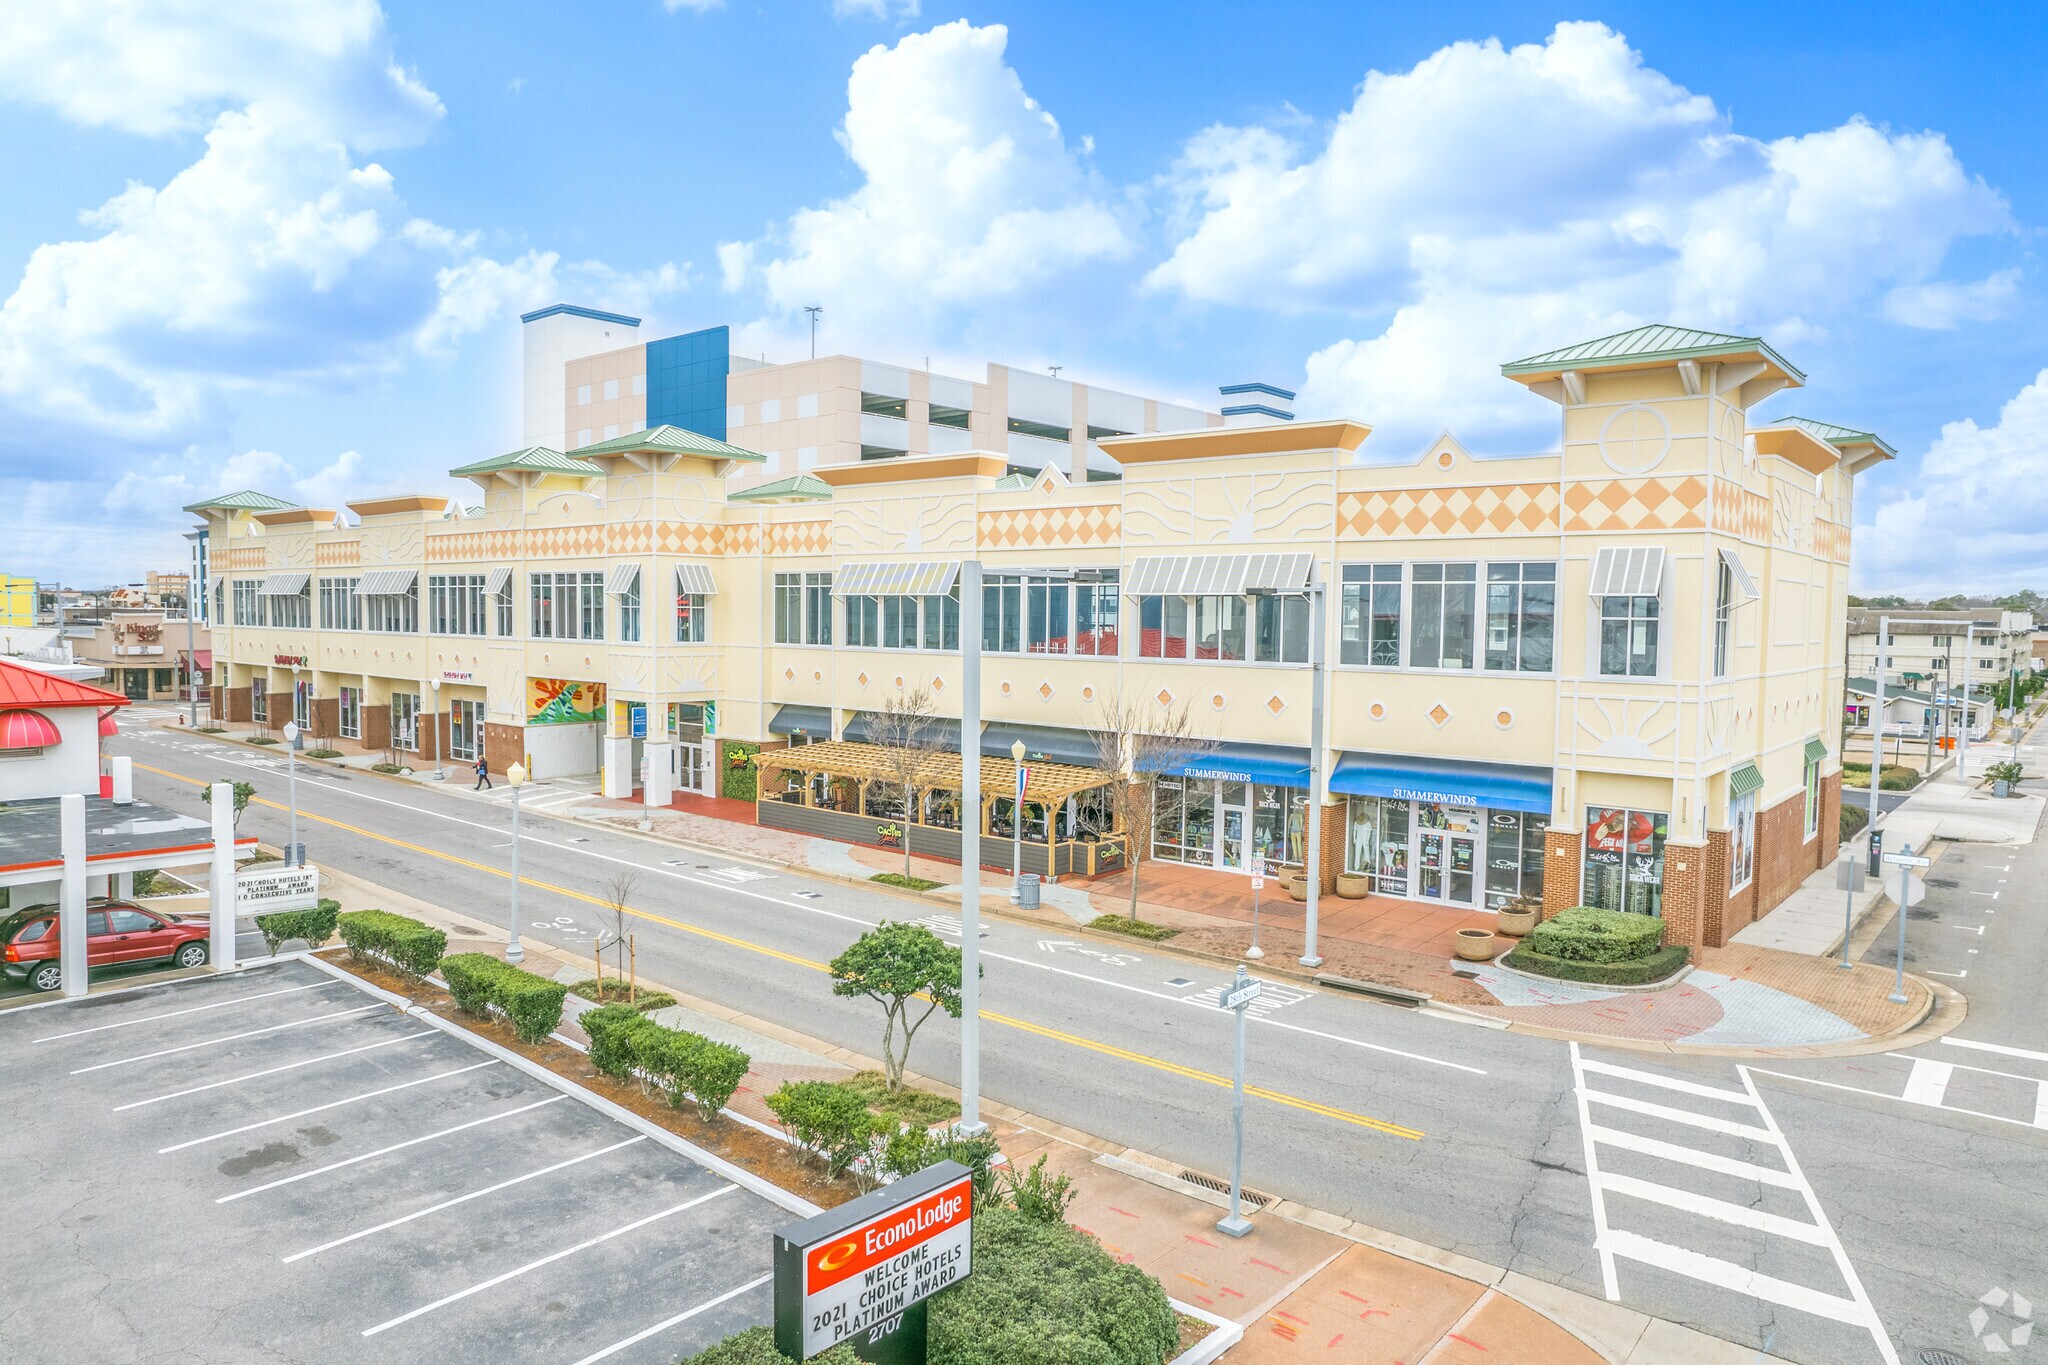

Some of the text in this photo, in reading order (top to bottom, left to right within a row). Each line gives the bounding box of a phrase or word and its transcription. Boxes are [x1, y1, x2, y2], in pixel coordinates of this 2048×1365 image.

[1184, 767, 1252, 782] SUMMERWINDS
[1393, 788, 1477, 806] SUMMERWINDS
[247, 881, 309, 893] PLATINUM AWARD
[254, 878, 277, 886] CHOICE
[279, 875, 301, 883] HOTELS
[1644, 875, 1660, 885] WEAR
[250, 889, 292, 899] CONSECUTIVE
[1243, 986, 1260, 1000] Street
[864, 1243, 929, 1288] WELCOME
[813, 1244, 962, 1332] 2021 CHOICE HOTELS
[834, 1265, 957, 1341] PLATINUM AWARD
[868, 1312, 904, 1345] 2707
